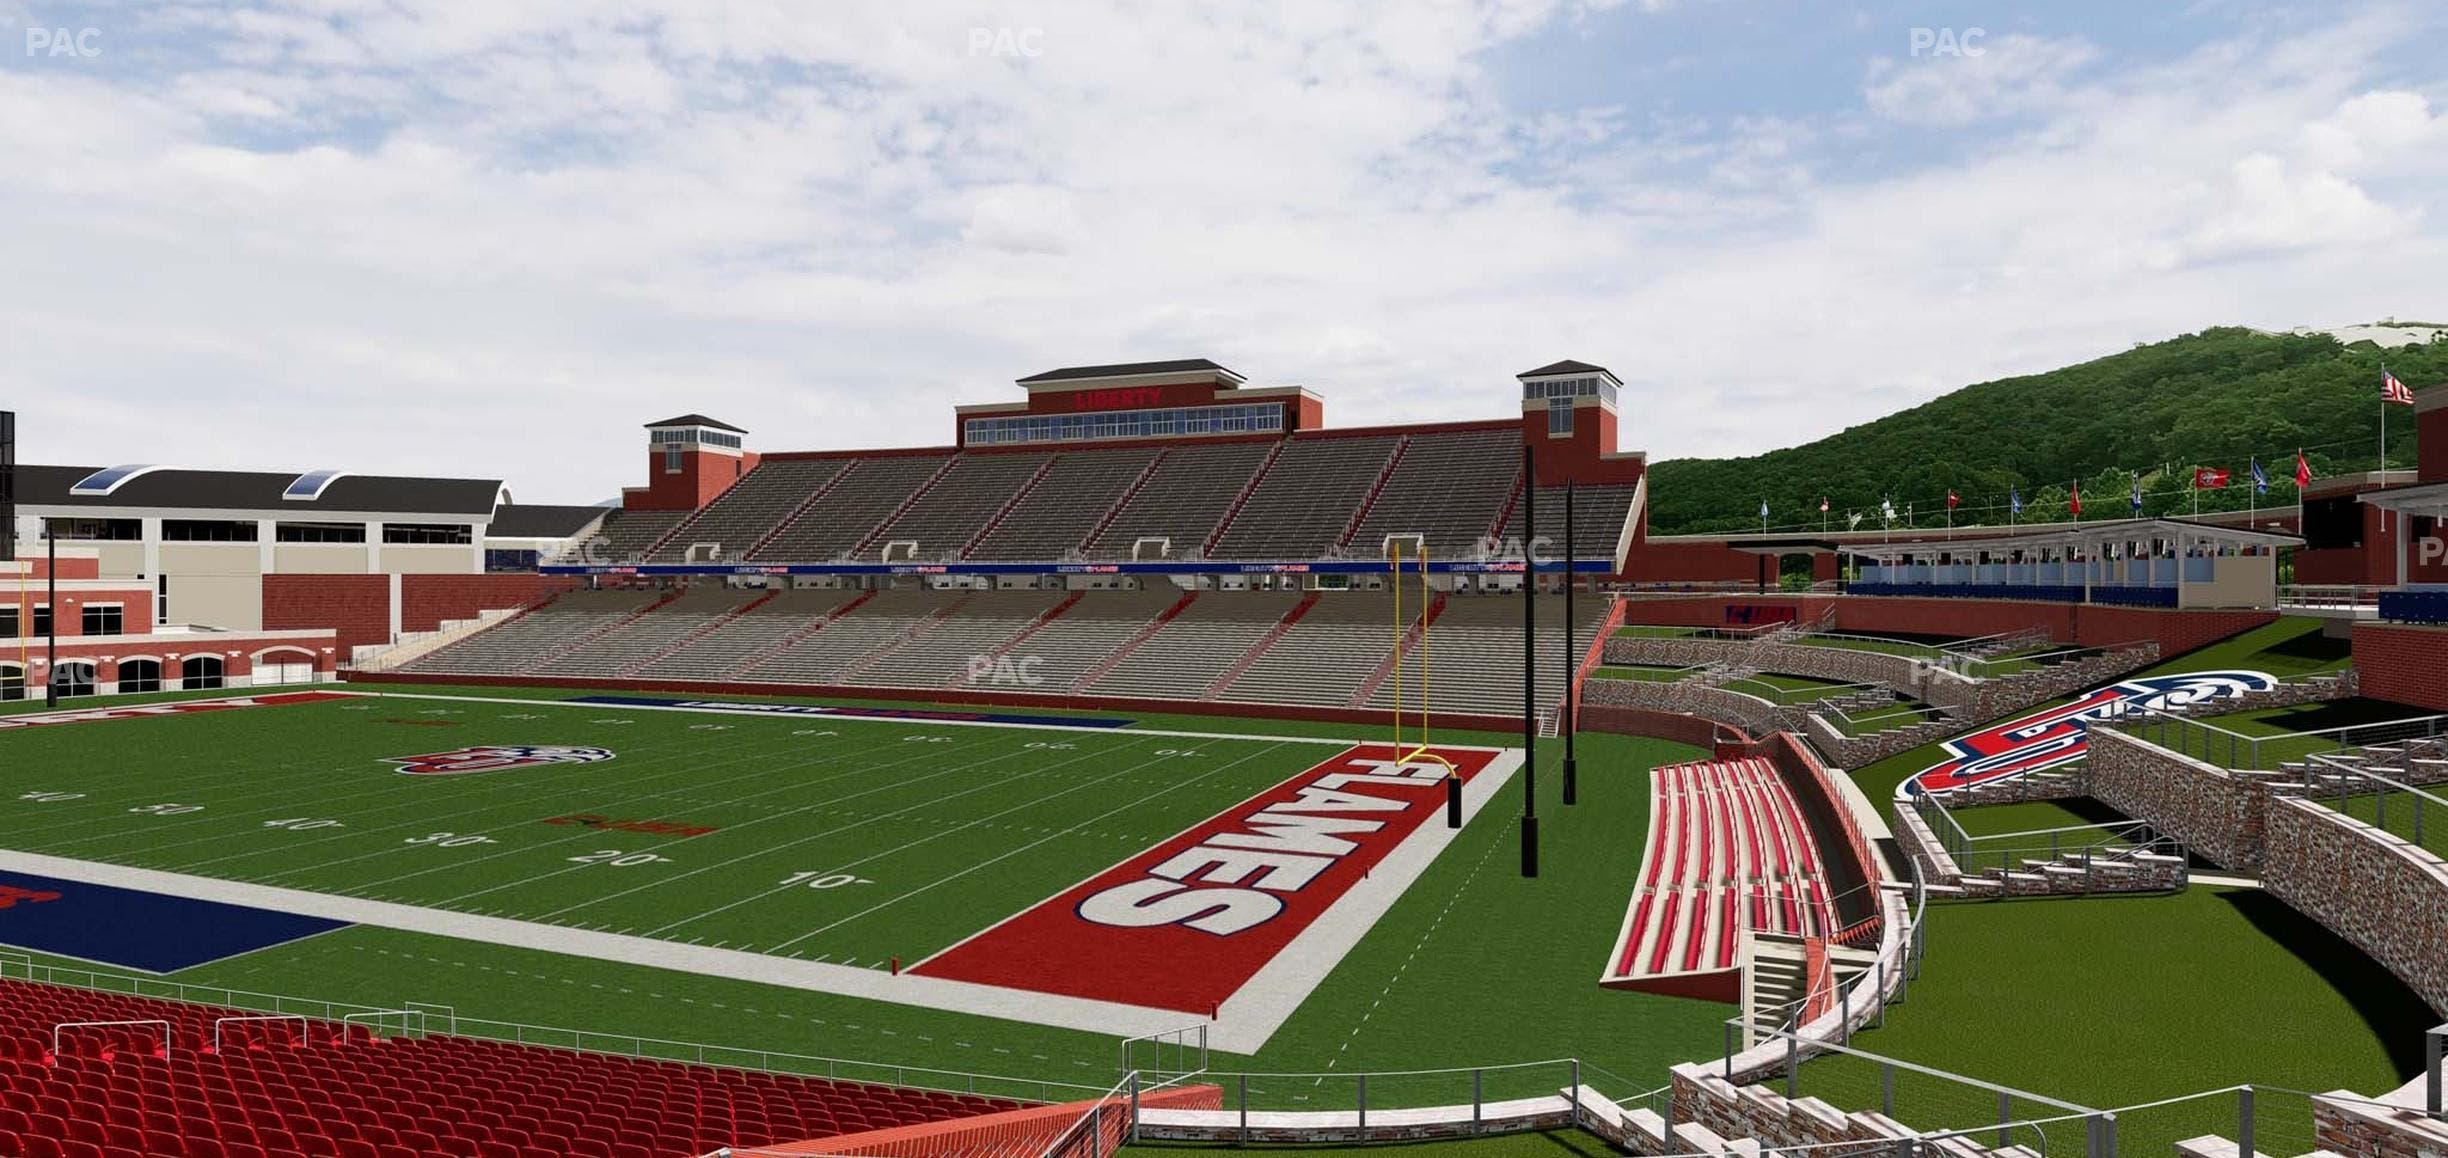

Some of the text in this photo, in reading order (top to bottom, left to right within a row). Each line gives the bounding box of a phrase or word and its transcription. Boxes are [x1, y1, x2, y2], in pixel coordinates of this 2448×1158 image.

[1074, 387, 1161, 409] LIBERTY
[263, 817, 335, 830] 40
[404, 832, 479, 847] 30
[1075, 759, 1460, 937] FLAMES
[567, 850, 659, 867] 20
[778, 871, 856, 889] 10
